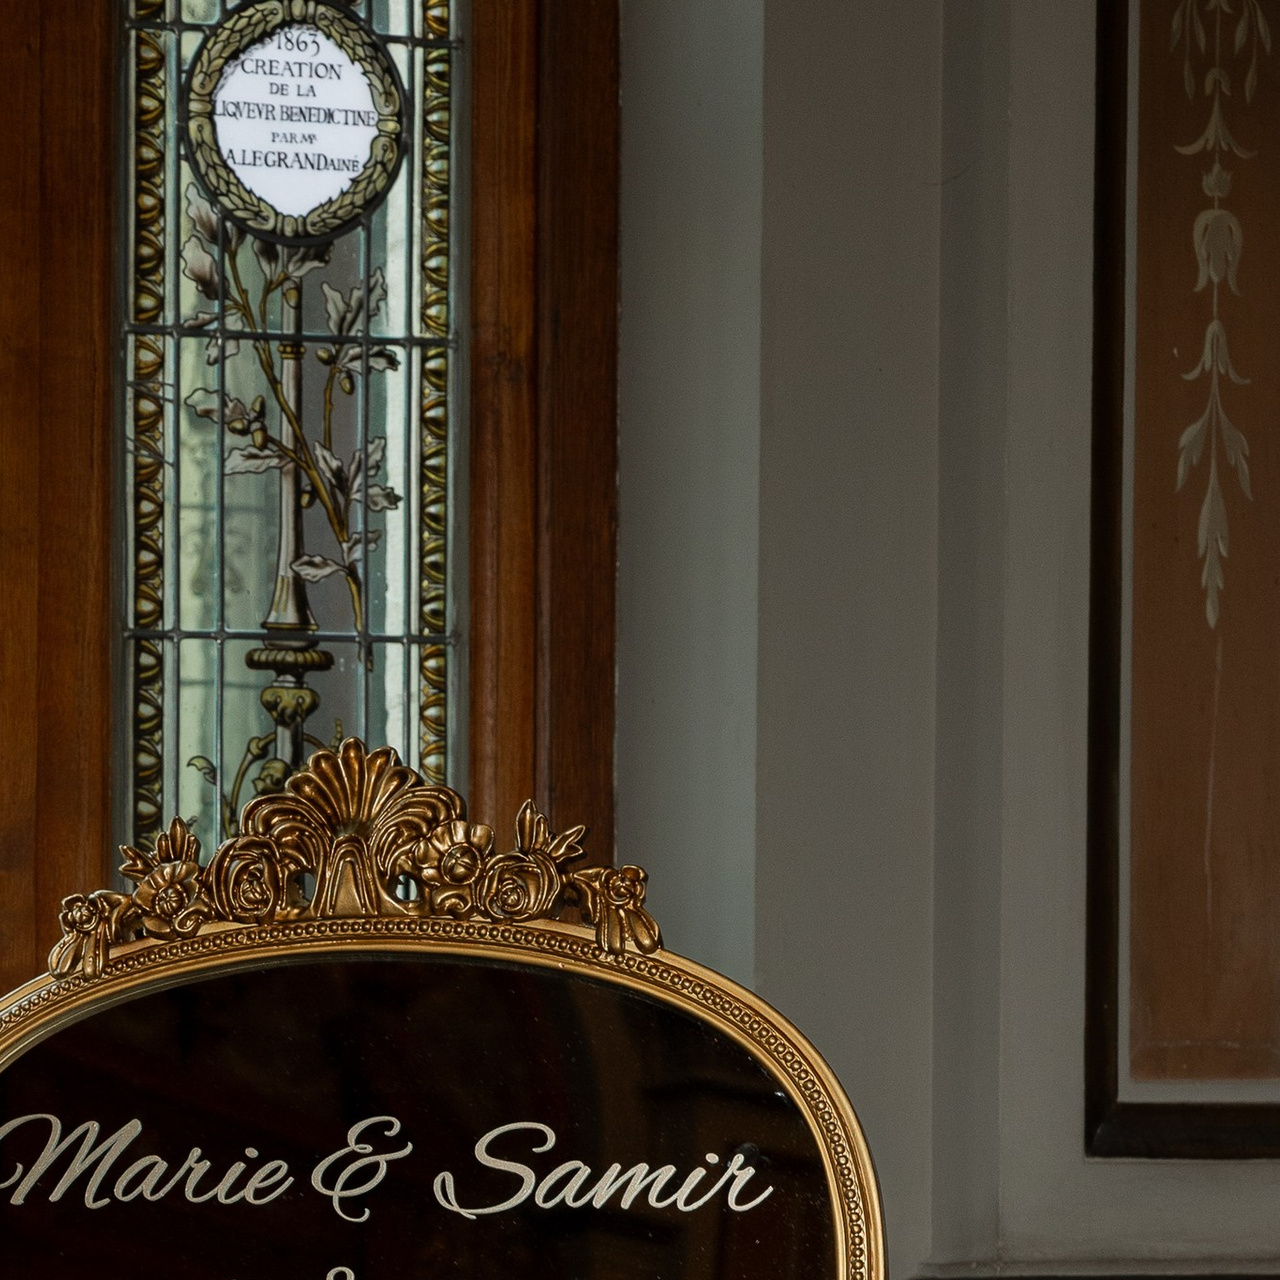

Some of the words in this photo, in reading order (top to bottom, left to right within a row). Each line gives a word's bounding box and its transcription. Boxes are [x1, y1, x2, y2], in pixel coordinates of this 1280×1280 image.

[276, 30, 320, 57] 1863
[241, 58, 343, 80] CREATION
[269, 82, 289, 96] DE
[297, 84, 317, 97] LA
[280, 104, 377, 127] BENEDICTINE
[271, 132, 298, 144] PAR
[311, 1115, 414, 1223] &
[433, 1121, 774, 1220] Samir
